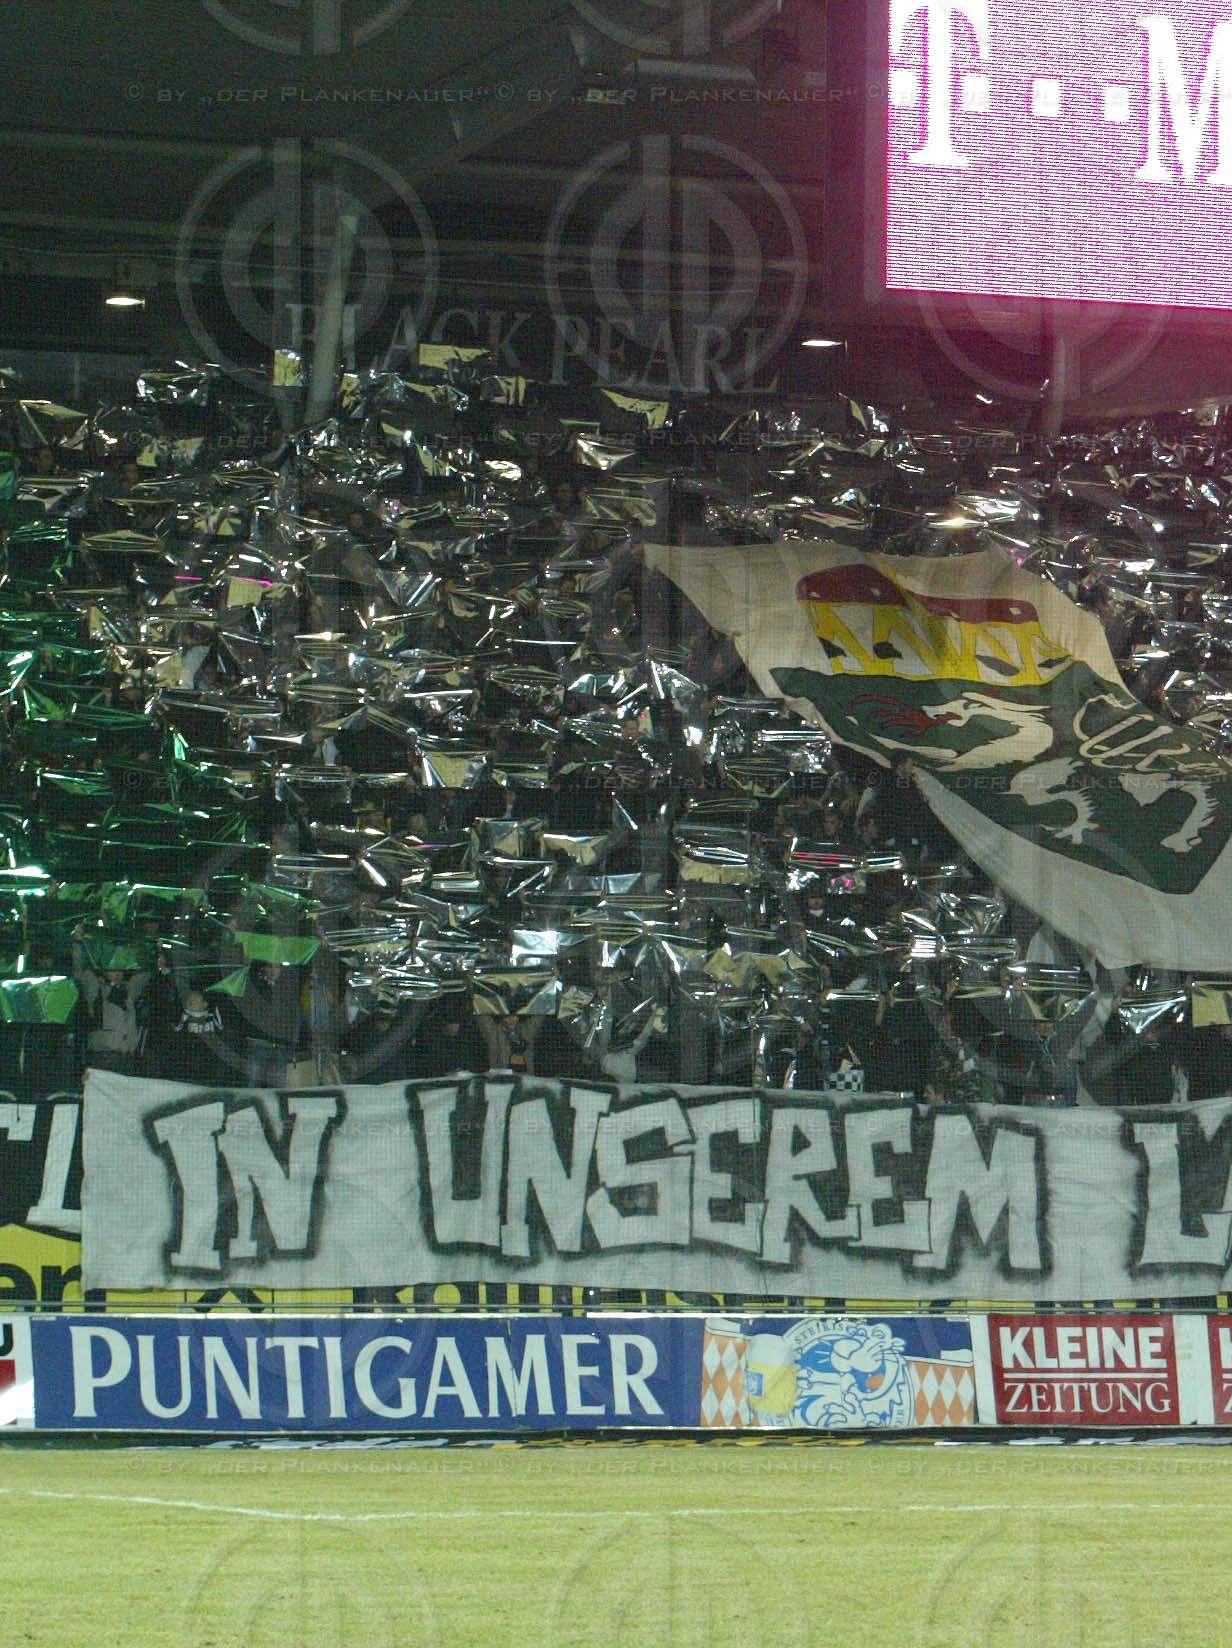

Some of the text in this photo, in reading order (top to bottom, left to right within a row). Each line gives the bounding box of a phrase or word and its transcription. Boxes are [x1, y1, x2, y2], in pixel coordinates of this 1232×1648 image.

[550, 313, 778, 394] PEARL
[144, 1089, 346, 1275] IN
[407, 1077, 1050, 1274] UNSEREM
[69, 1325, 666, 1419] PUNTIGAMER
[1000, 1325, 1166, 1370] KLEINE
[1004, 1381, 1172, 1415] ZEITUNG
